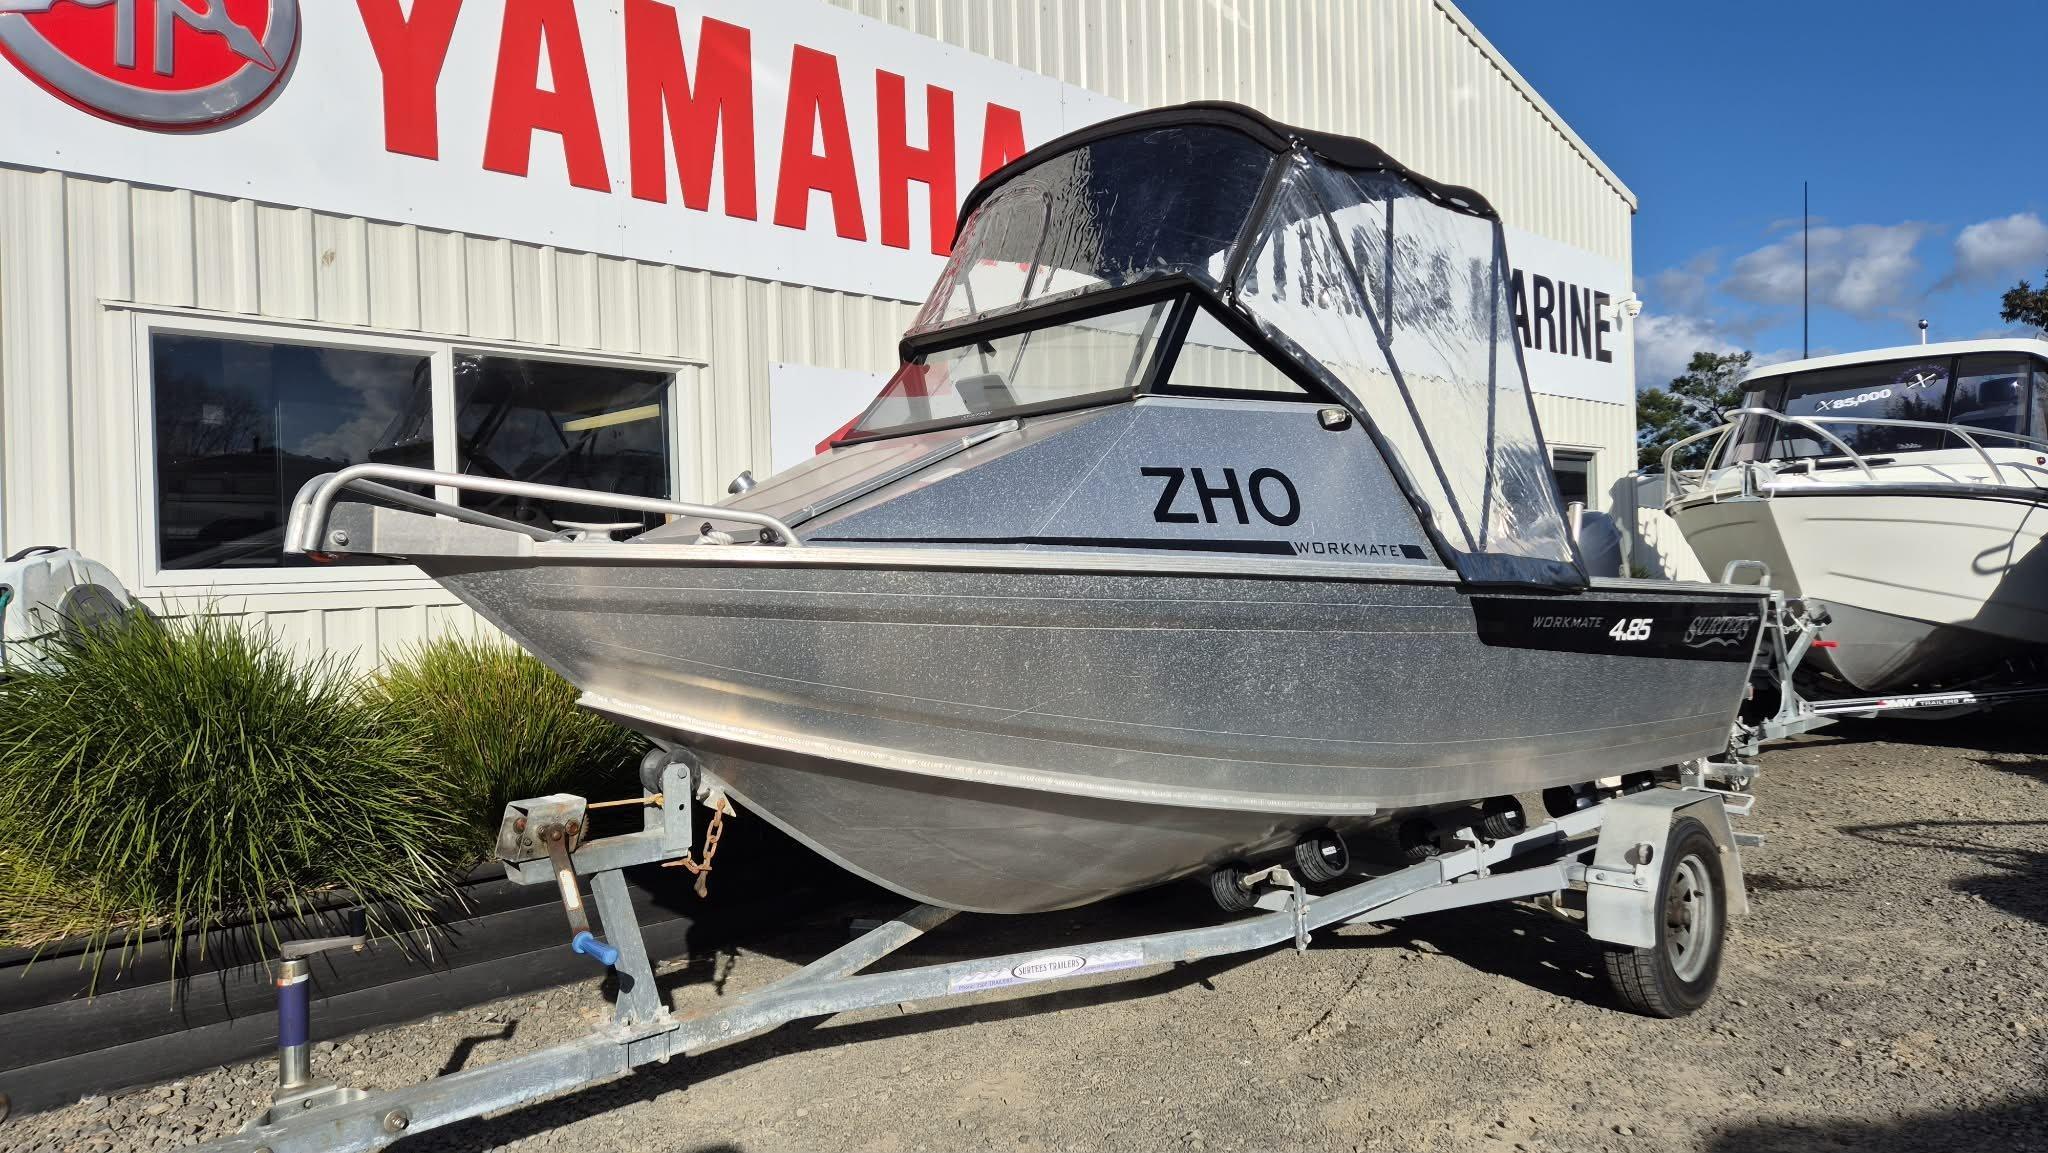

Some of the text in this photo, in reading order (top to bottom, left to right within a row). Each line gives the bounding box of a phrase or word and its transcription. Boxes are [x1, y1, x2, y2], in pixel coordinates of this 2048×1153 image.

[1511, 267, 1613, 363] ARINE
[1140, 466, 1301, 527] ZHO
[1293, 541, 1400, 557] WORKMATE
[1532, 616, 1654, 641] WORKMATE 4.85
[1018, 962, 1048, 976] SURTEES
[1048, 959, 1080, 971] TRAILERS
